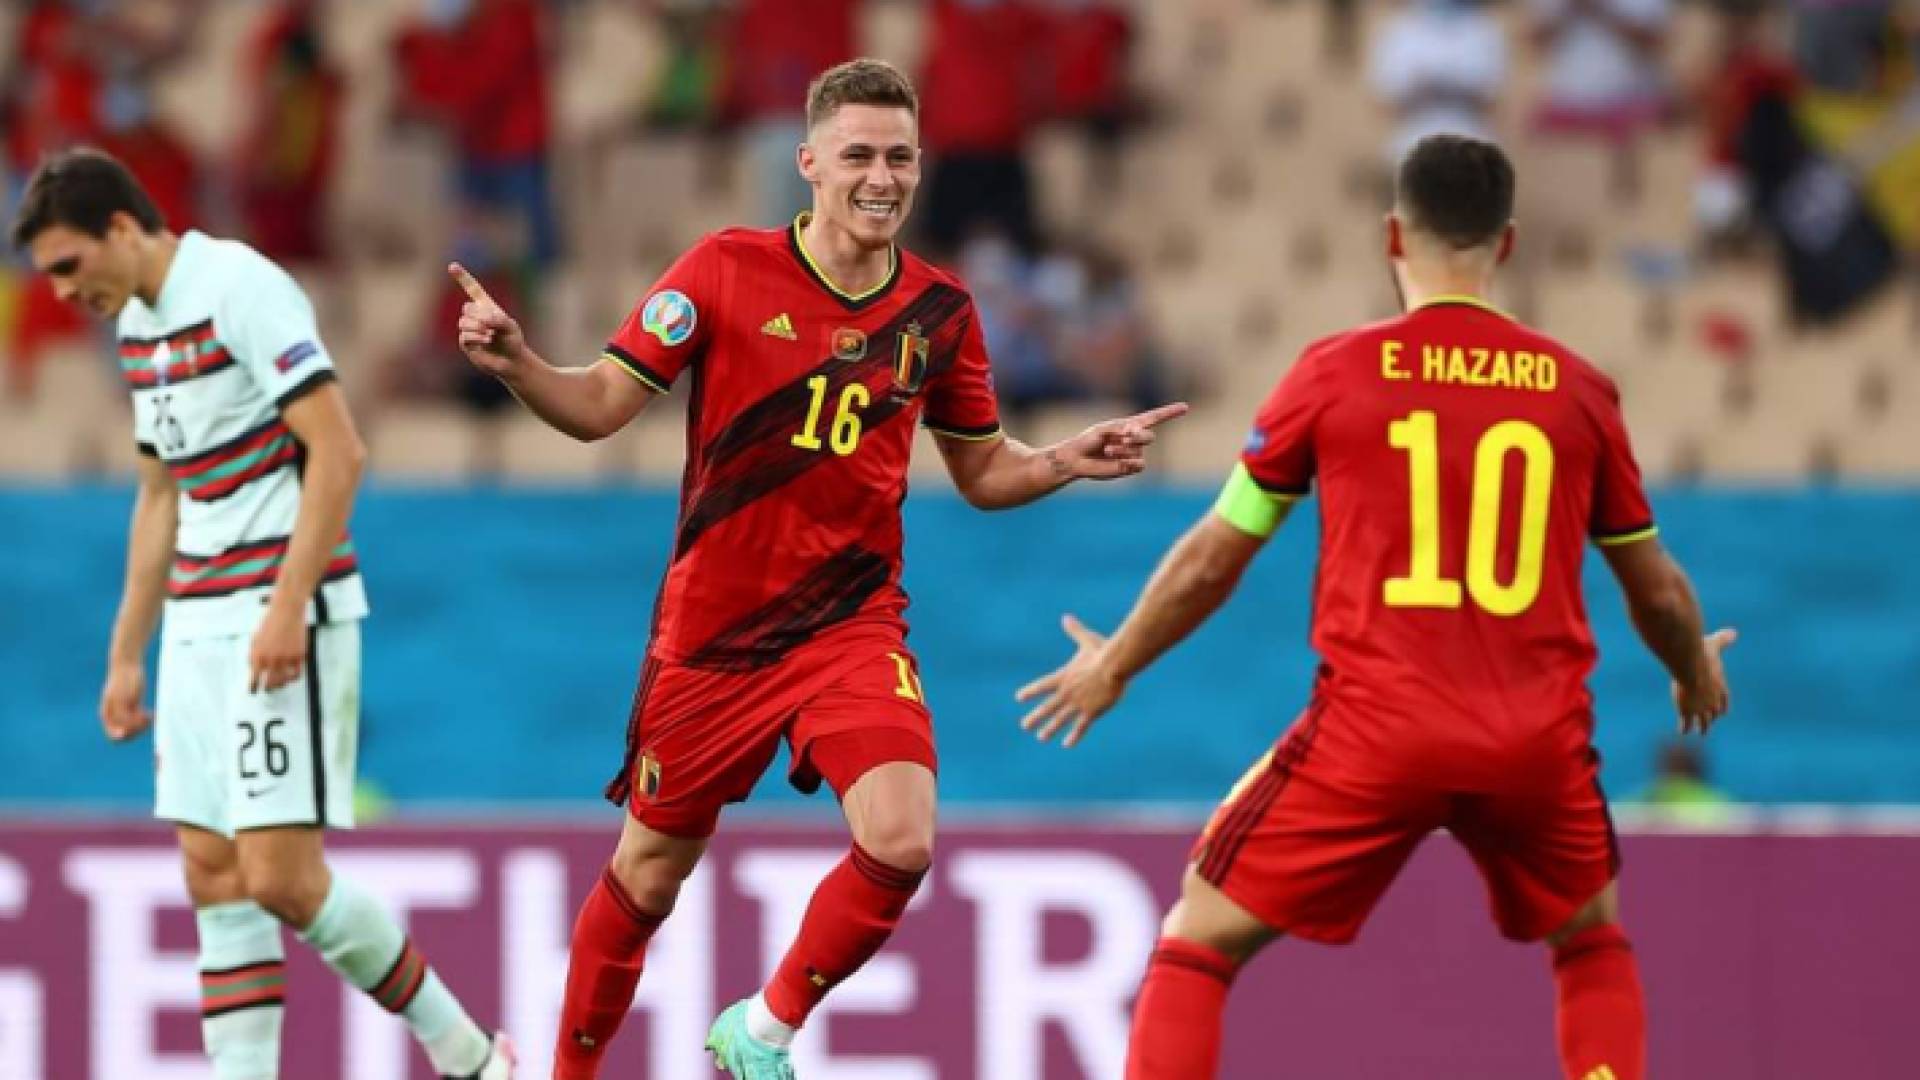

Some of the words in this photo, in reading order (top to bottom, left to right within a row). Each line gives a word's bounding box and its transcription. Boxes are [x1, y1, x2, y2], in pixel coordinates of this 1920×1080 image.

[1381, 340, 1412, 379] E.
[1423, 345, 1558, 391] HAZARD
[790, 375, 870, 456] 16
[1383, 410, 1554, 616] 10
[886, 652, 924, 705] 1
[236, 717, 289, 779] 26
